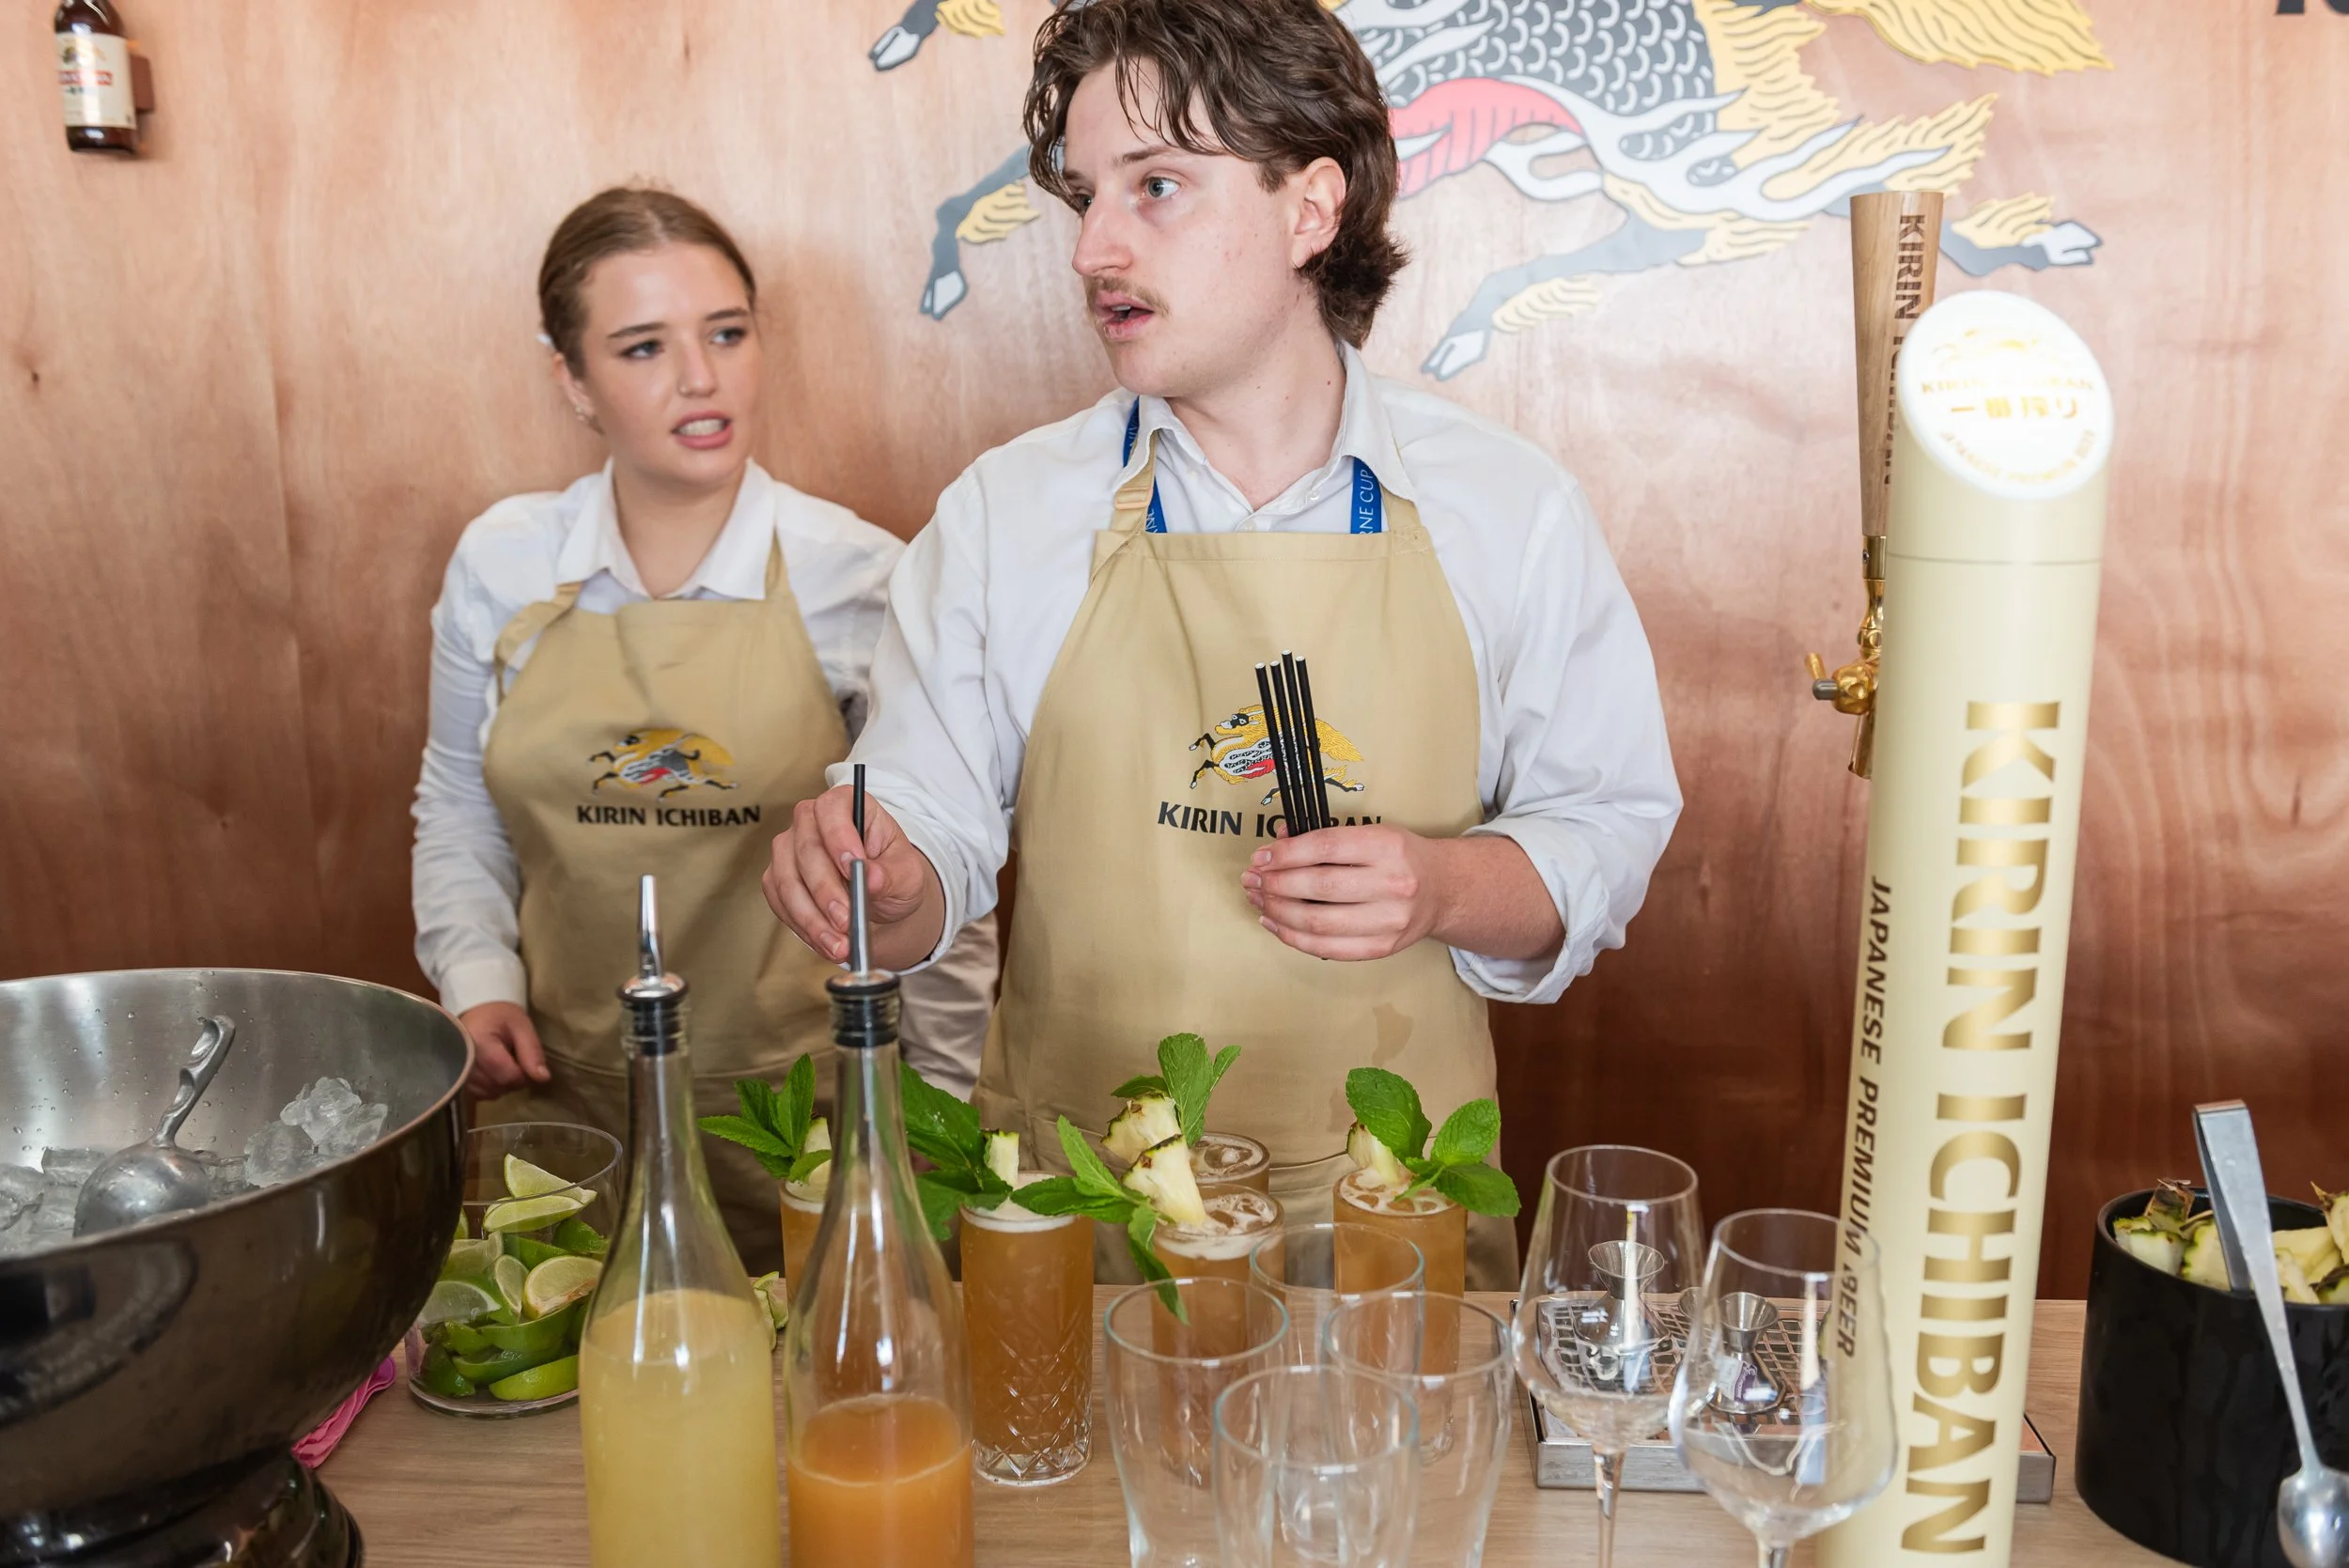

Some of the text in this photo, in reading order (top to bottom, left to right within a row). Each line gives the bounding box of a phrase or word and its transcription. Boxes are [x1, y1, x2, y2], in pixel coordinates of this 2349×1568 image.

[1893, 214, 1925, 319] KIRIN
[1359, 469, 1374, 534] NE CUP
[577, 805, 761, 827] KIRIN ICHIBAN
[1158, 800, 1242, 836] KIRIN
[1838, 876, 1891, 1358] JAPANESE PREMIUM BEER
[1901, 701, 2061, 1555] KIRIN ICHIBAN
